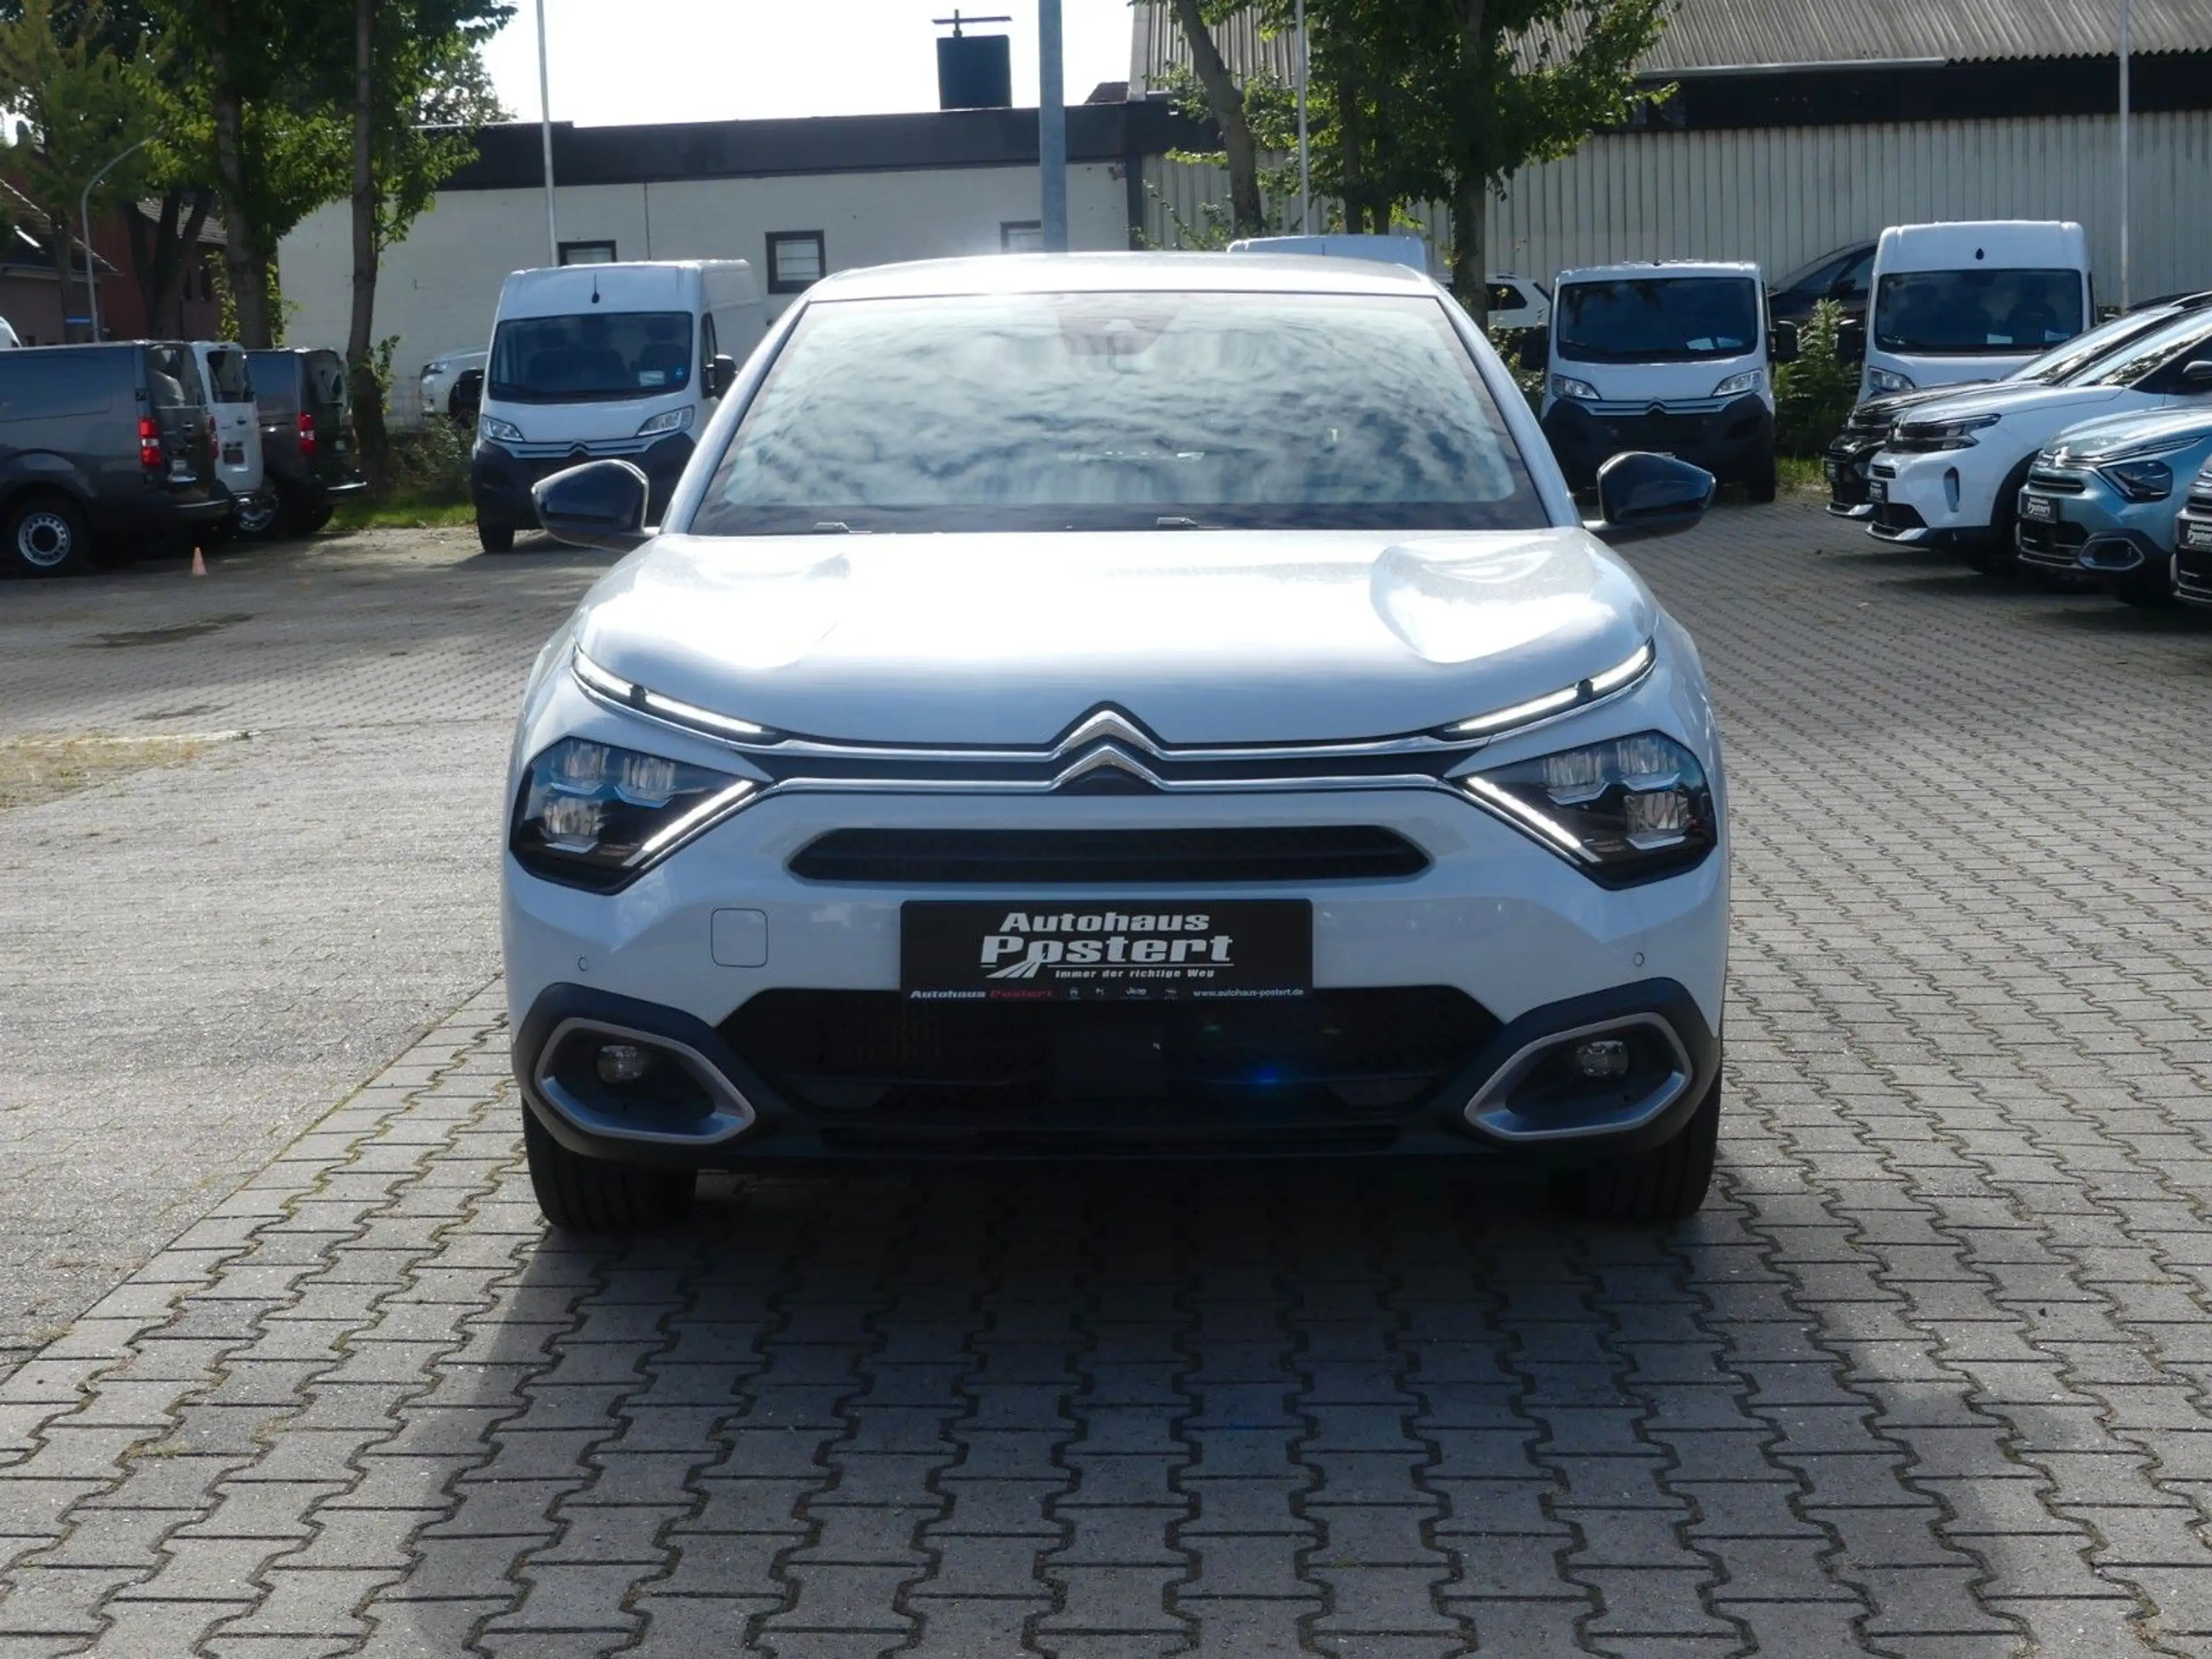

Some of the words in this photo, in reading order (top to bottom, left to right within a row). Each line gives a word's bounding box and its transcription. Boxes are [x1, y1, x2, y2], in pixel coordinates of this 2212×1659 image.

[999, 912, 1210, 932] Autohaus
[980, 935, 1233, 964] Postert
[1055, 969, 1097, 978] Immer
[1102, 969, 1124, 978] der
[1129, 968, 1181, 978] richtige
[1187, 968, 1215, 978] Weg
[910, 990, 986, 998] Autohaus
[1192, 988, 1305, 998] www.autohaus-postert.de
